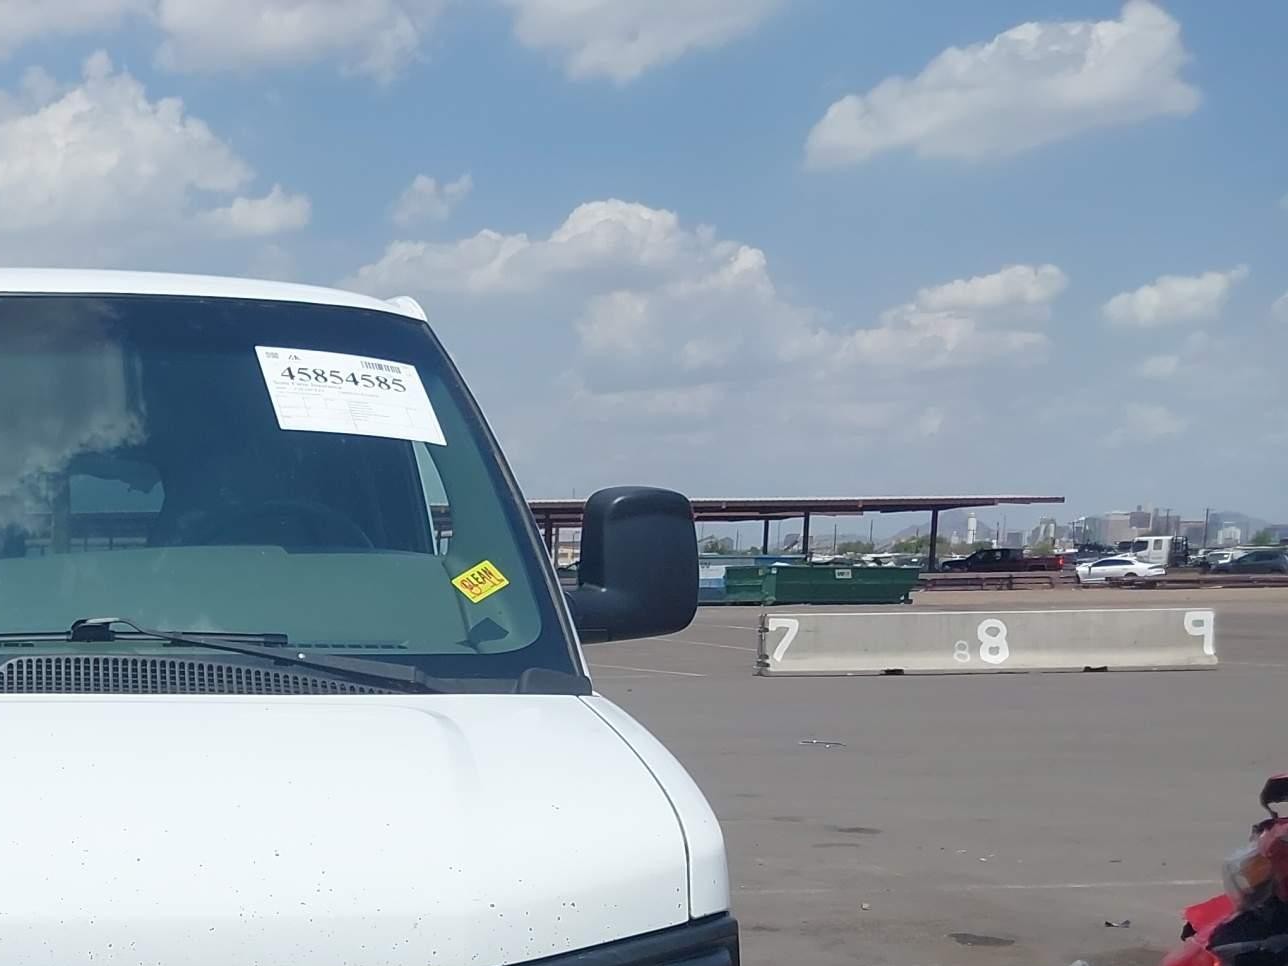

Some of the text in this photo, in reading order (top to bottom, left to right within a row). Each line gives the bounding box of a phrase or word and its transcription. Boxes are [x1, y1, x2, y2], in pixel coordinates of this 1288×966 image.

[280, 366, 408, 393] 45854585
[768, 618, 799, 662] 7
[953, 640, 970, 663] 8
[977, 618, 1009, 664] 8
[1183, 611, 1215, 655] 9
